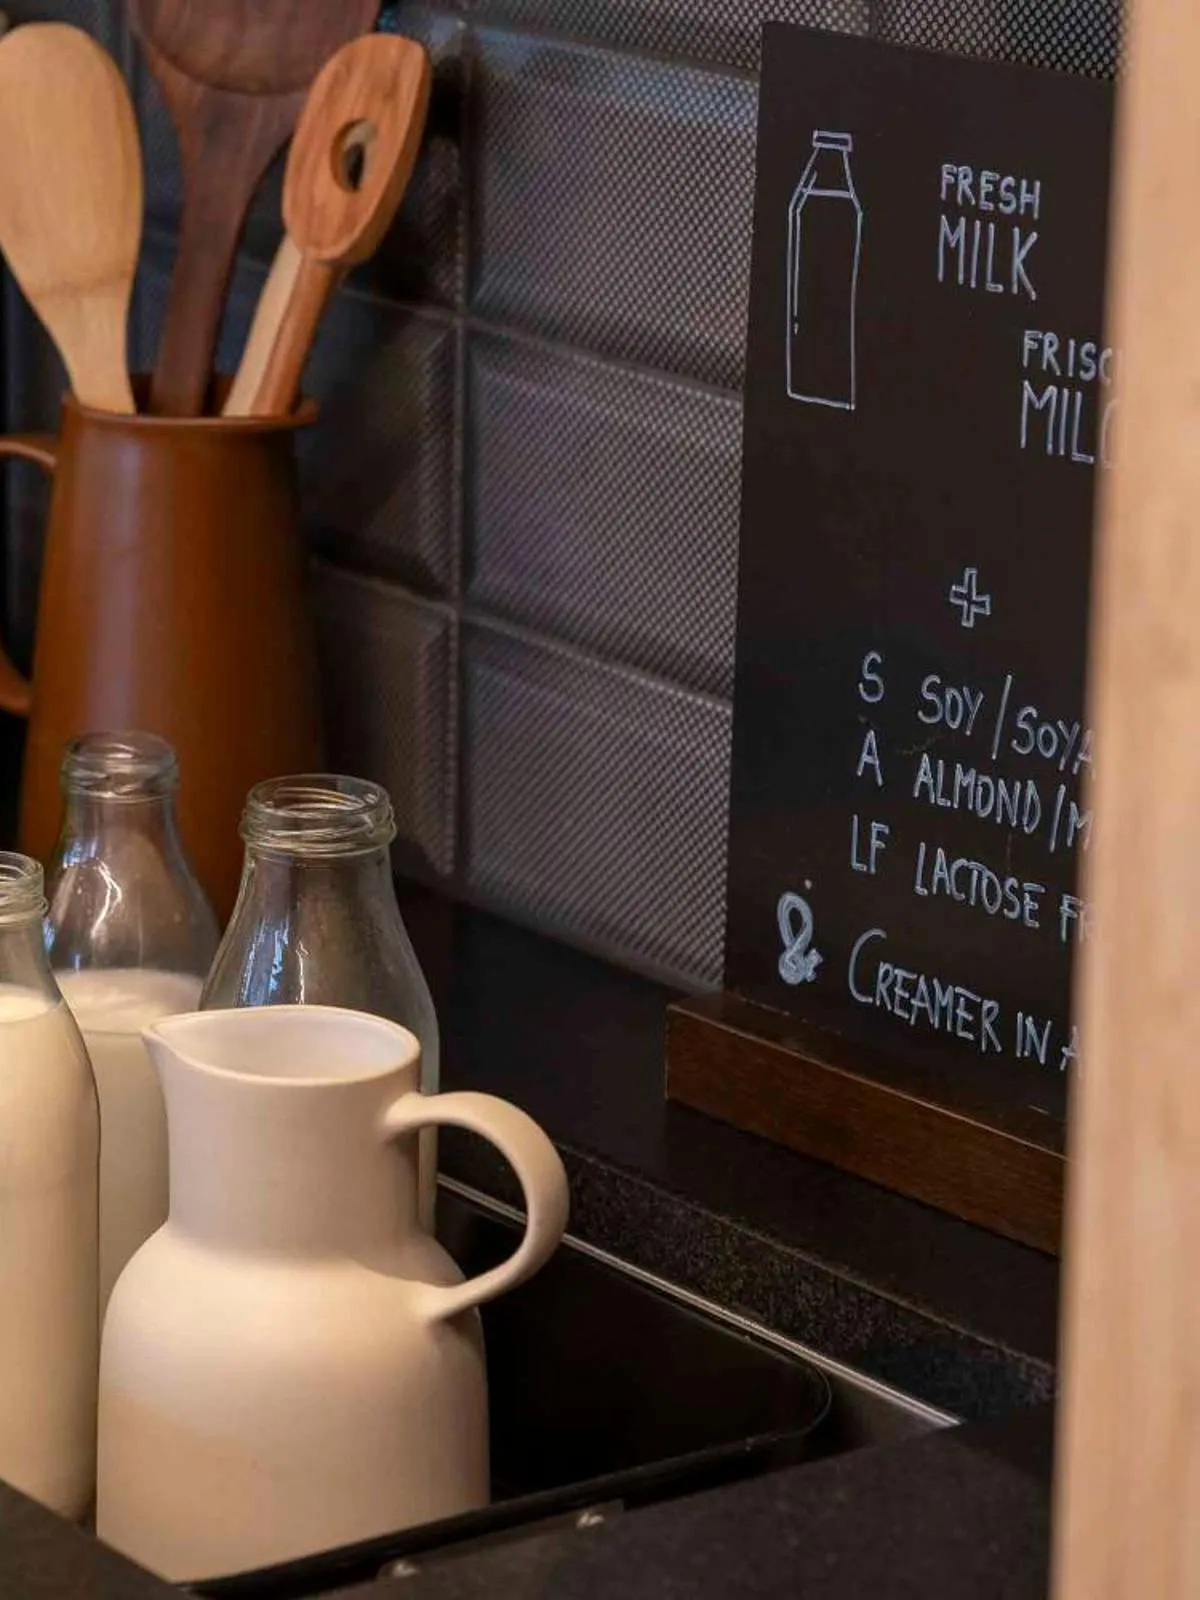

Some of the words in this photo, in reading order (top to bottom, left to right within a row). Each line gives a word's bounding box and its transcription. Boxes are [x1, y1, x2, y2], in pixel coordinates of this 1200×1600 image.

[940, 163, 1041, 219] FRESH
[938, 214, 1038, 301] MILK
[1022, 330, 1117, 387] FRISC
[858, 651, 885, 702] S
[857, 729, 884, 787] A
[850, 814, 890, 875] LF
[914, 842, 1046, 928] LACTOSE
[848, 928, 1002, 1053] CREAMER
[1015, 1010, 1053, 1065] IN
